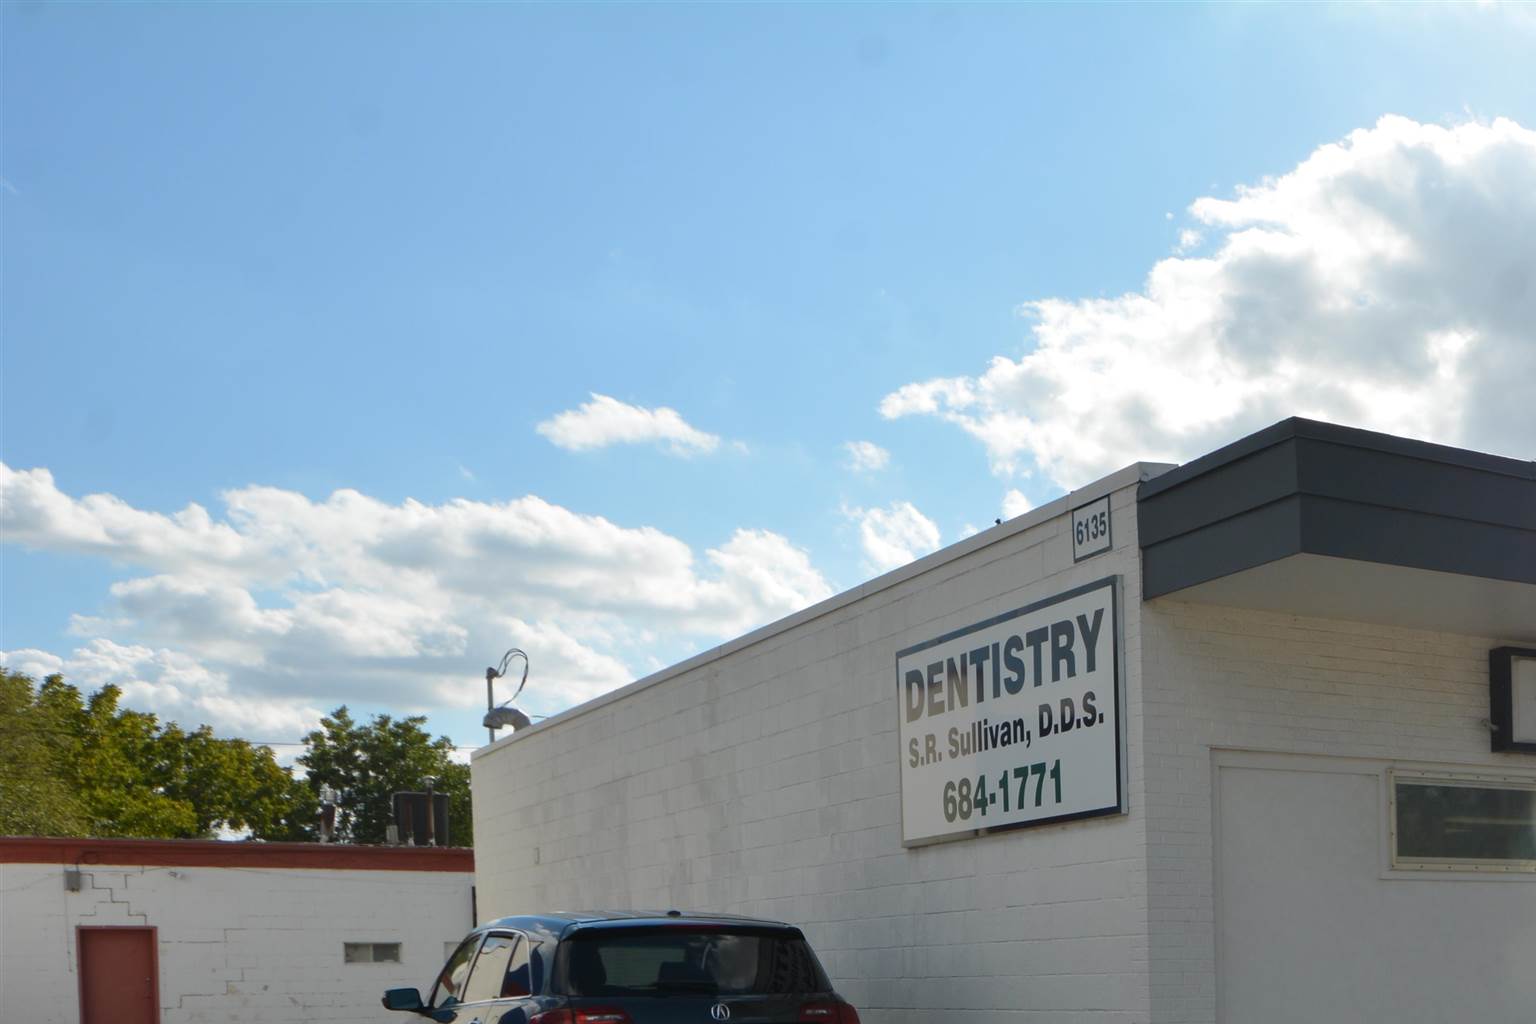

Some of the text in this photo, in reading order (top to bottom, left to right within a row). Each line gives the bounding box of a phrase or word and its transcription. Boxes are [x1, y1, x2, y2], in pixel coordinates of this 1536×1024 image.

[1076, 512, 1107, 545] 6135
[905, 608, 1104, 723] DENTISTRY
[909, 691, 1105, 768] S.R. Sullivan, D.D.S.
[943, 758, 1063, 824] 684-1771
